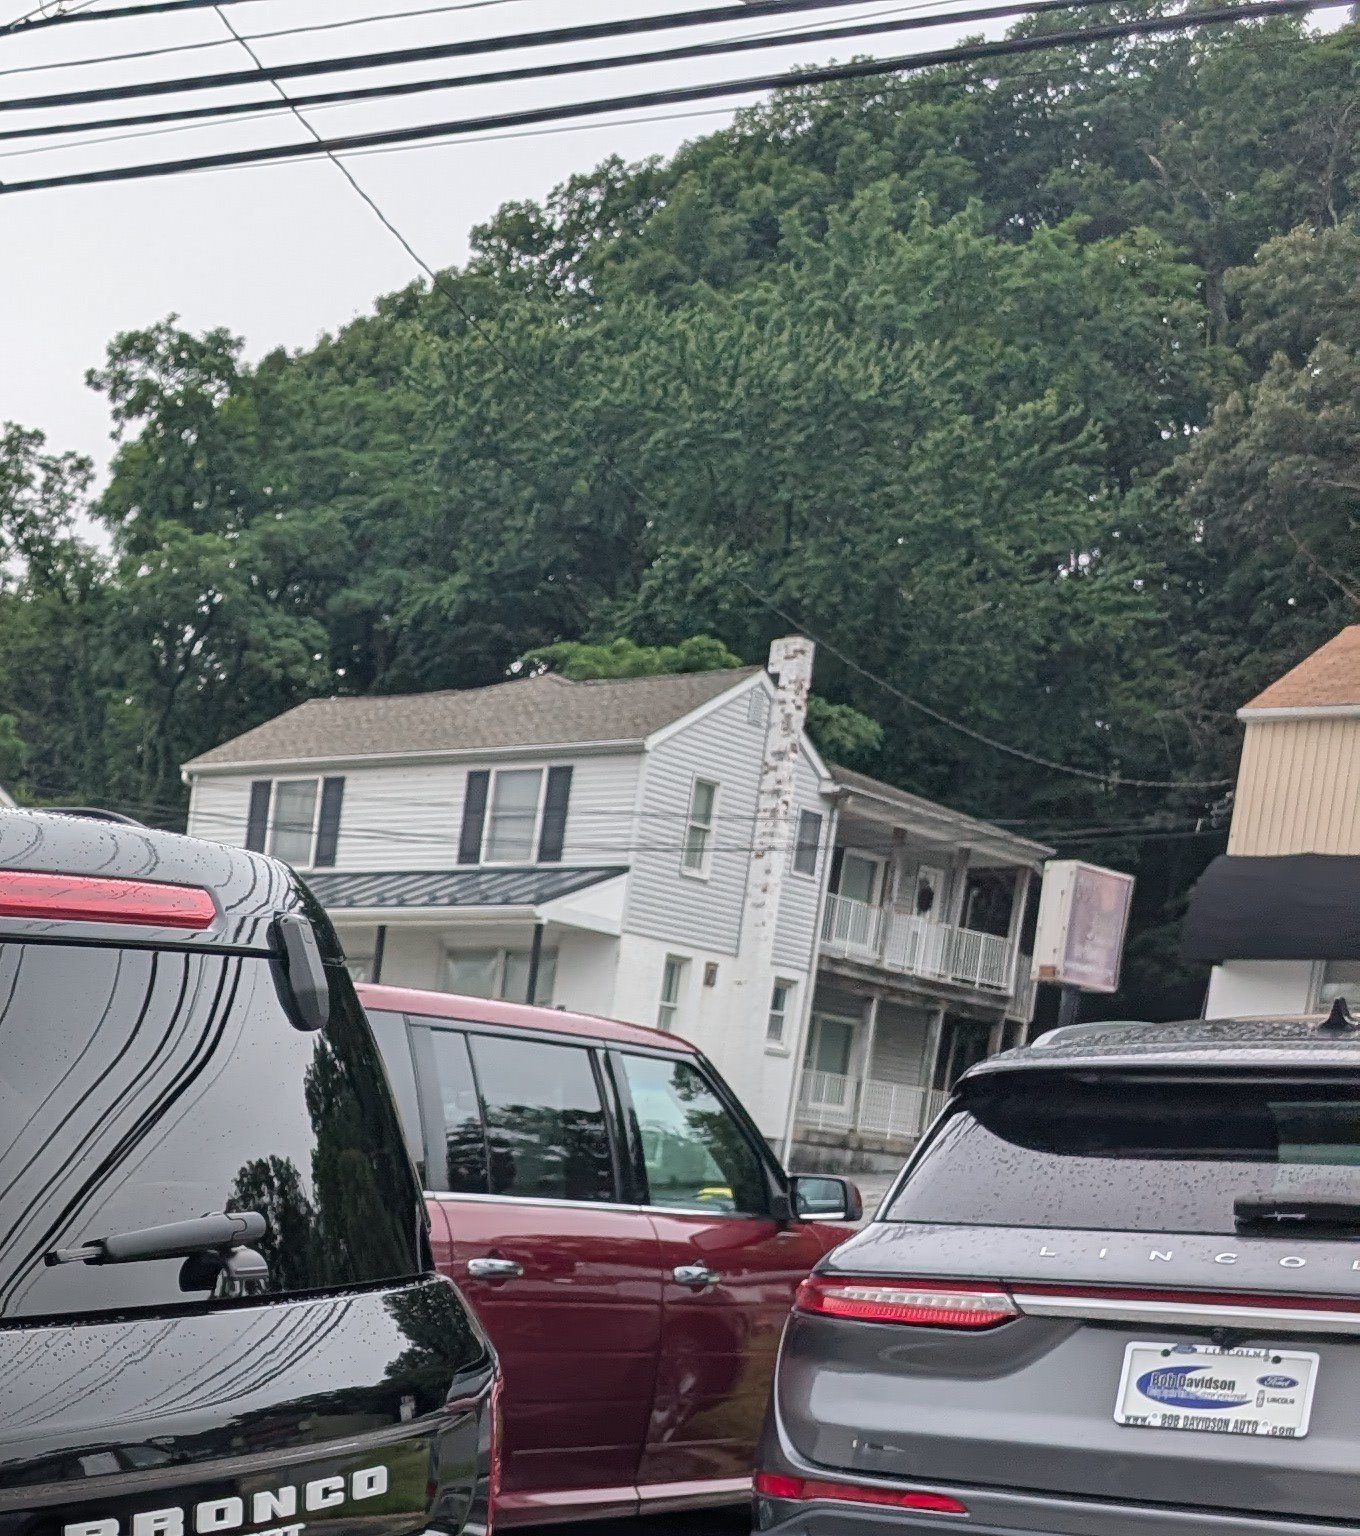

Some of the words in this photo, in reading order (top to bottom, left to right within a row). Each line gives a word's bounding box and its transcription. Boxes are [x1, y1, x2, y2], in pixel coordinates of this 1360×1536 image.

[1151, 1372, 1174, 1390] Bob
[1179, 1374, 1236, 1393] Davidson
[1161, 1413, 1180, 1428] BOB
[1183, 1415, 1231, 1433] DAVIDSON
[1232, 1418, 1259, 1434] AUTO
